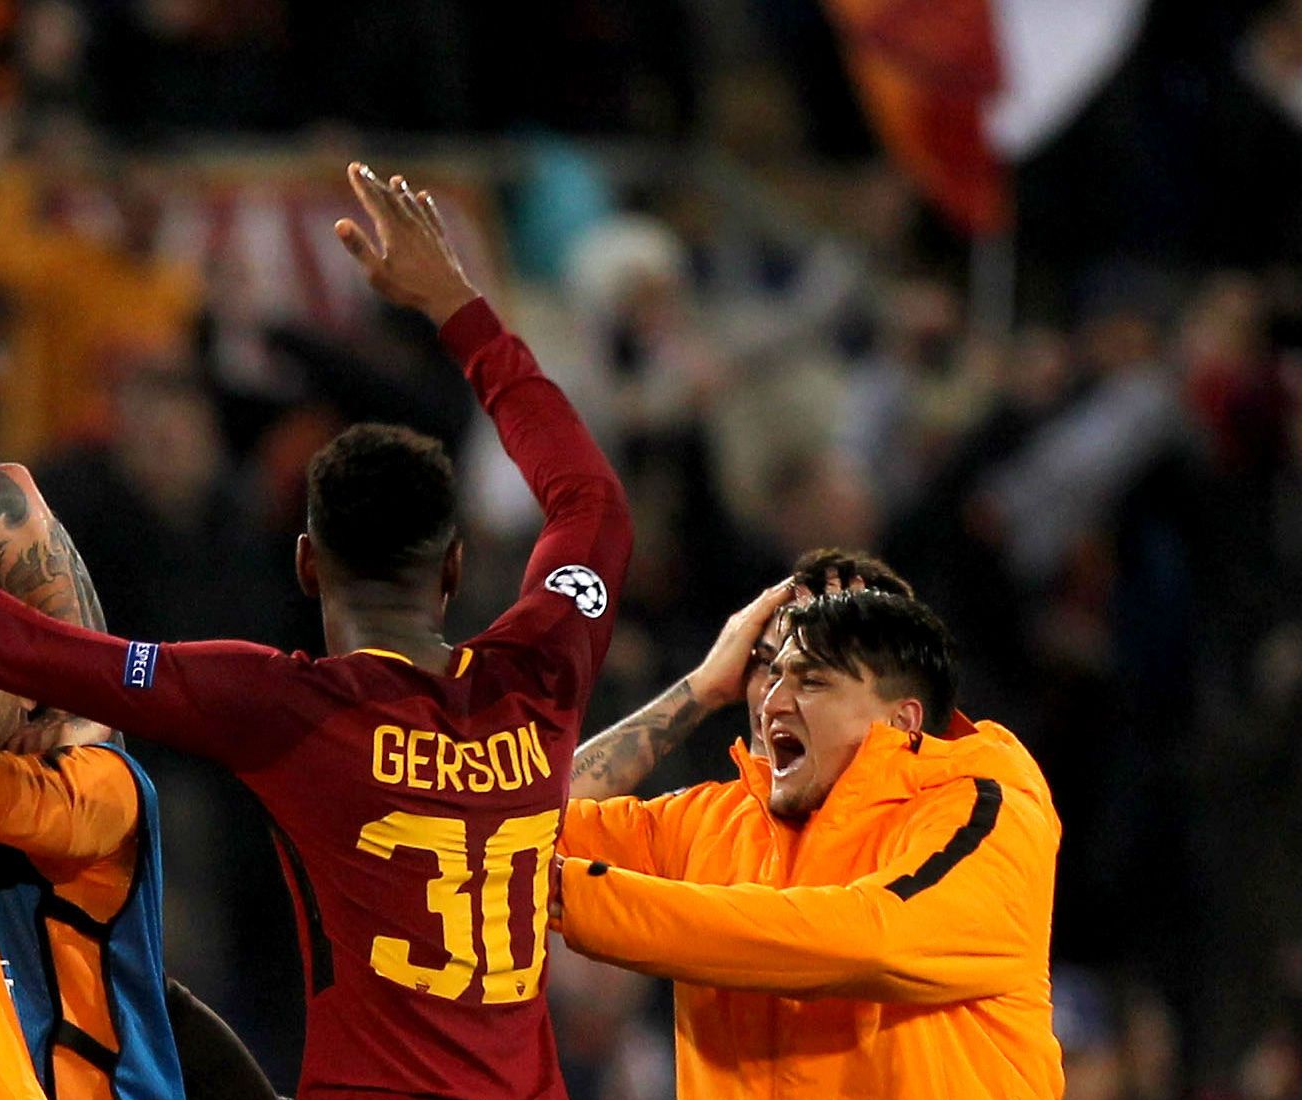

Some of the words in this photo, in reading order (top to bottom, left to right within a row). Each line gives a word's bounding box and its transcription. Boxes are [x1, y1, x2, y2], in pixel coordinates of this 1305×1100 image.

[131, 643, 150, 688] ESPECT
[372, 721, 551, 793] GERSON
[356, 808, 560, 1004] 30
